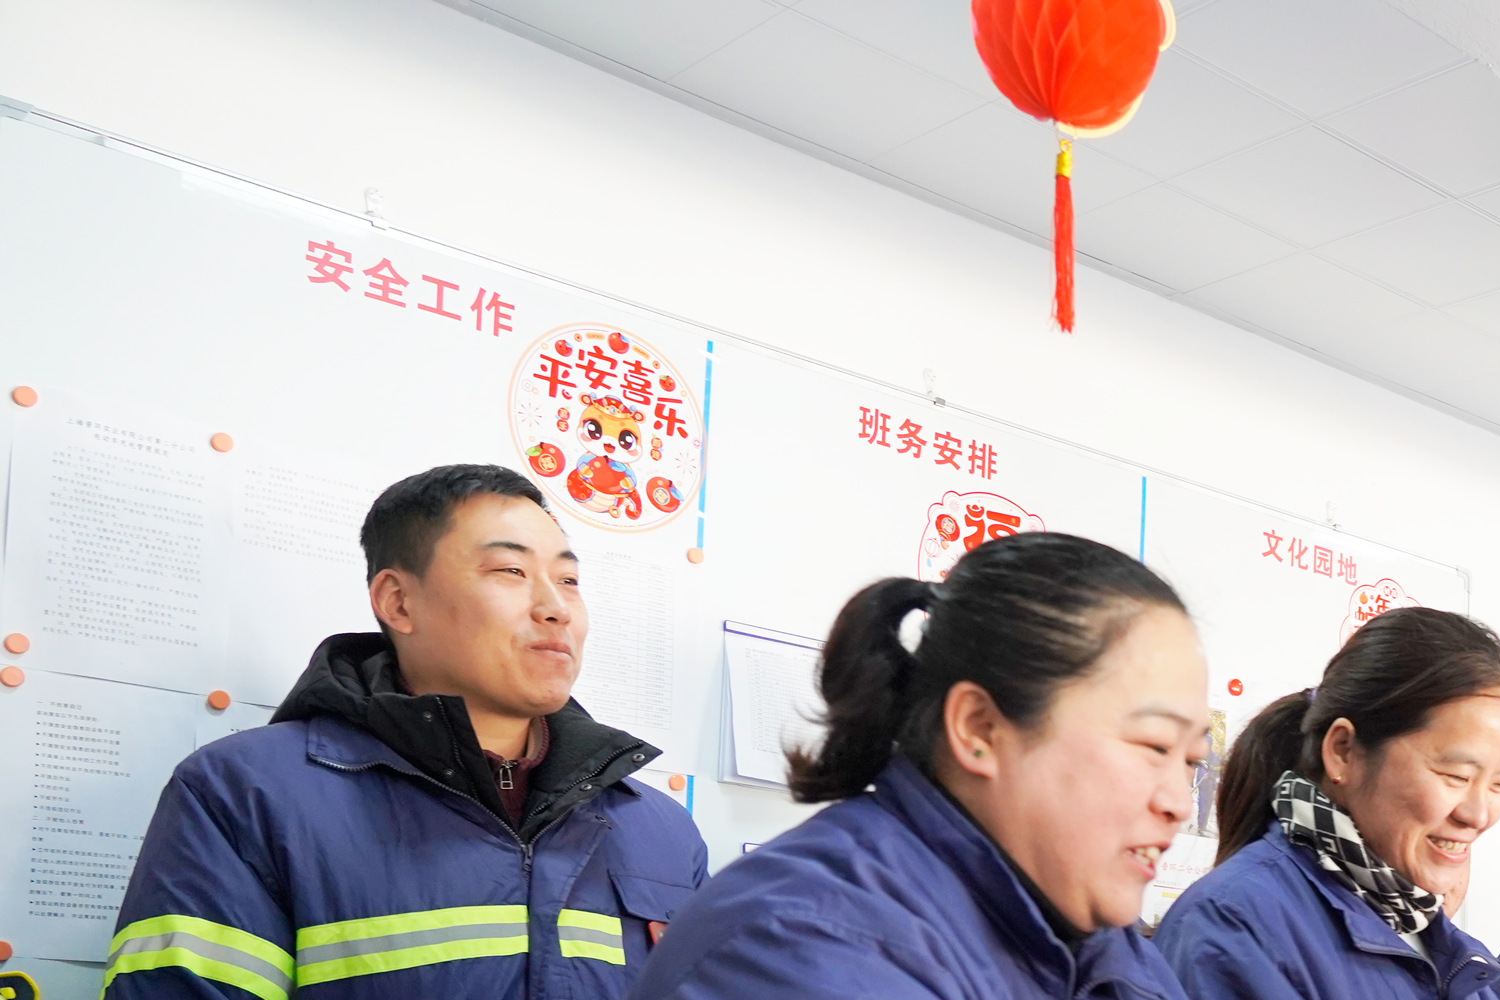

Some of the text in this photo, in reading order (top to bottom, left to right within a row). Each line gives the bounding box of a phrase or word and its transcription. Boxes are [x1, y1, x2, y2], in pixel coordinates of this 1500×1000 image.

[305, 239, 516, 338] 安全工作
[533, 345, 689, 439] 平安喜乐
[858, 405, 999, 480] 班务安排
[1260, 529, 1359, 586] 文化园地
